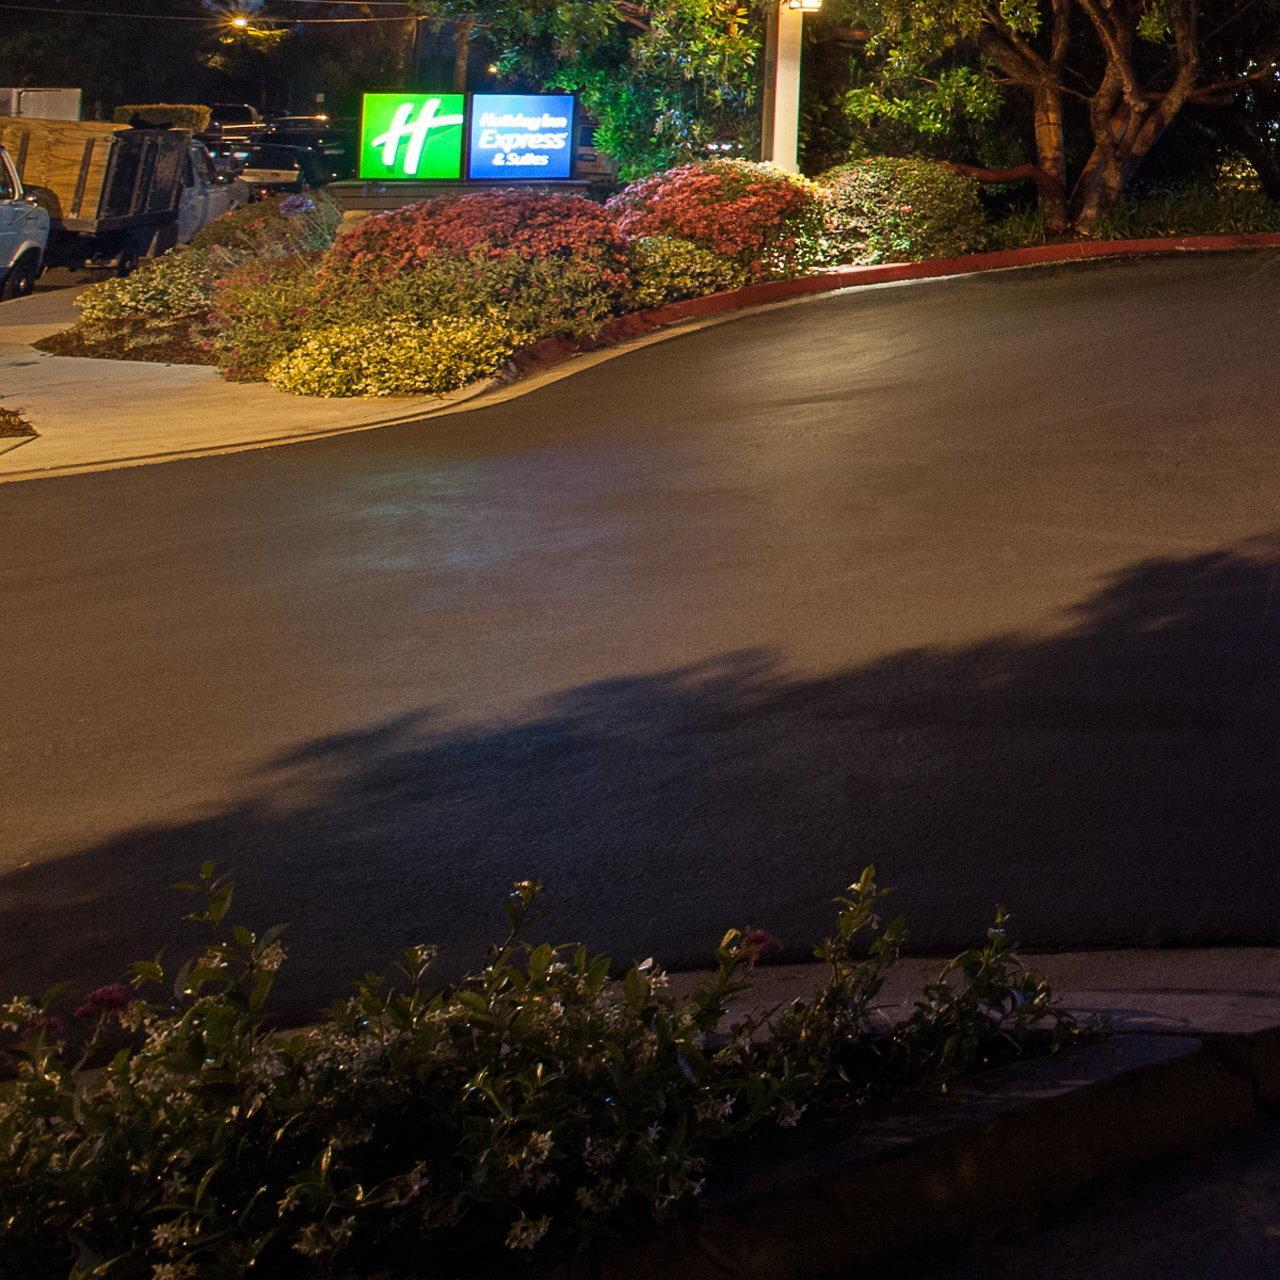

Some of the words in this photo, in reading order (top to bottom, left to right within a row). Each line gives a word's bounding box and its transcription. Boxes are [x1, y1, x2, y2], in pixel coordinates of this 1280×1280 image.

[478, 129, 567, 153] Express
[492, 152, 505, 166] &
[505, 152, 549, 166] Suites
